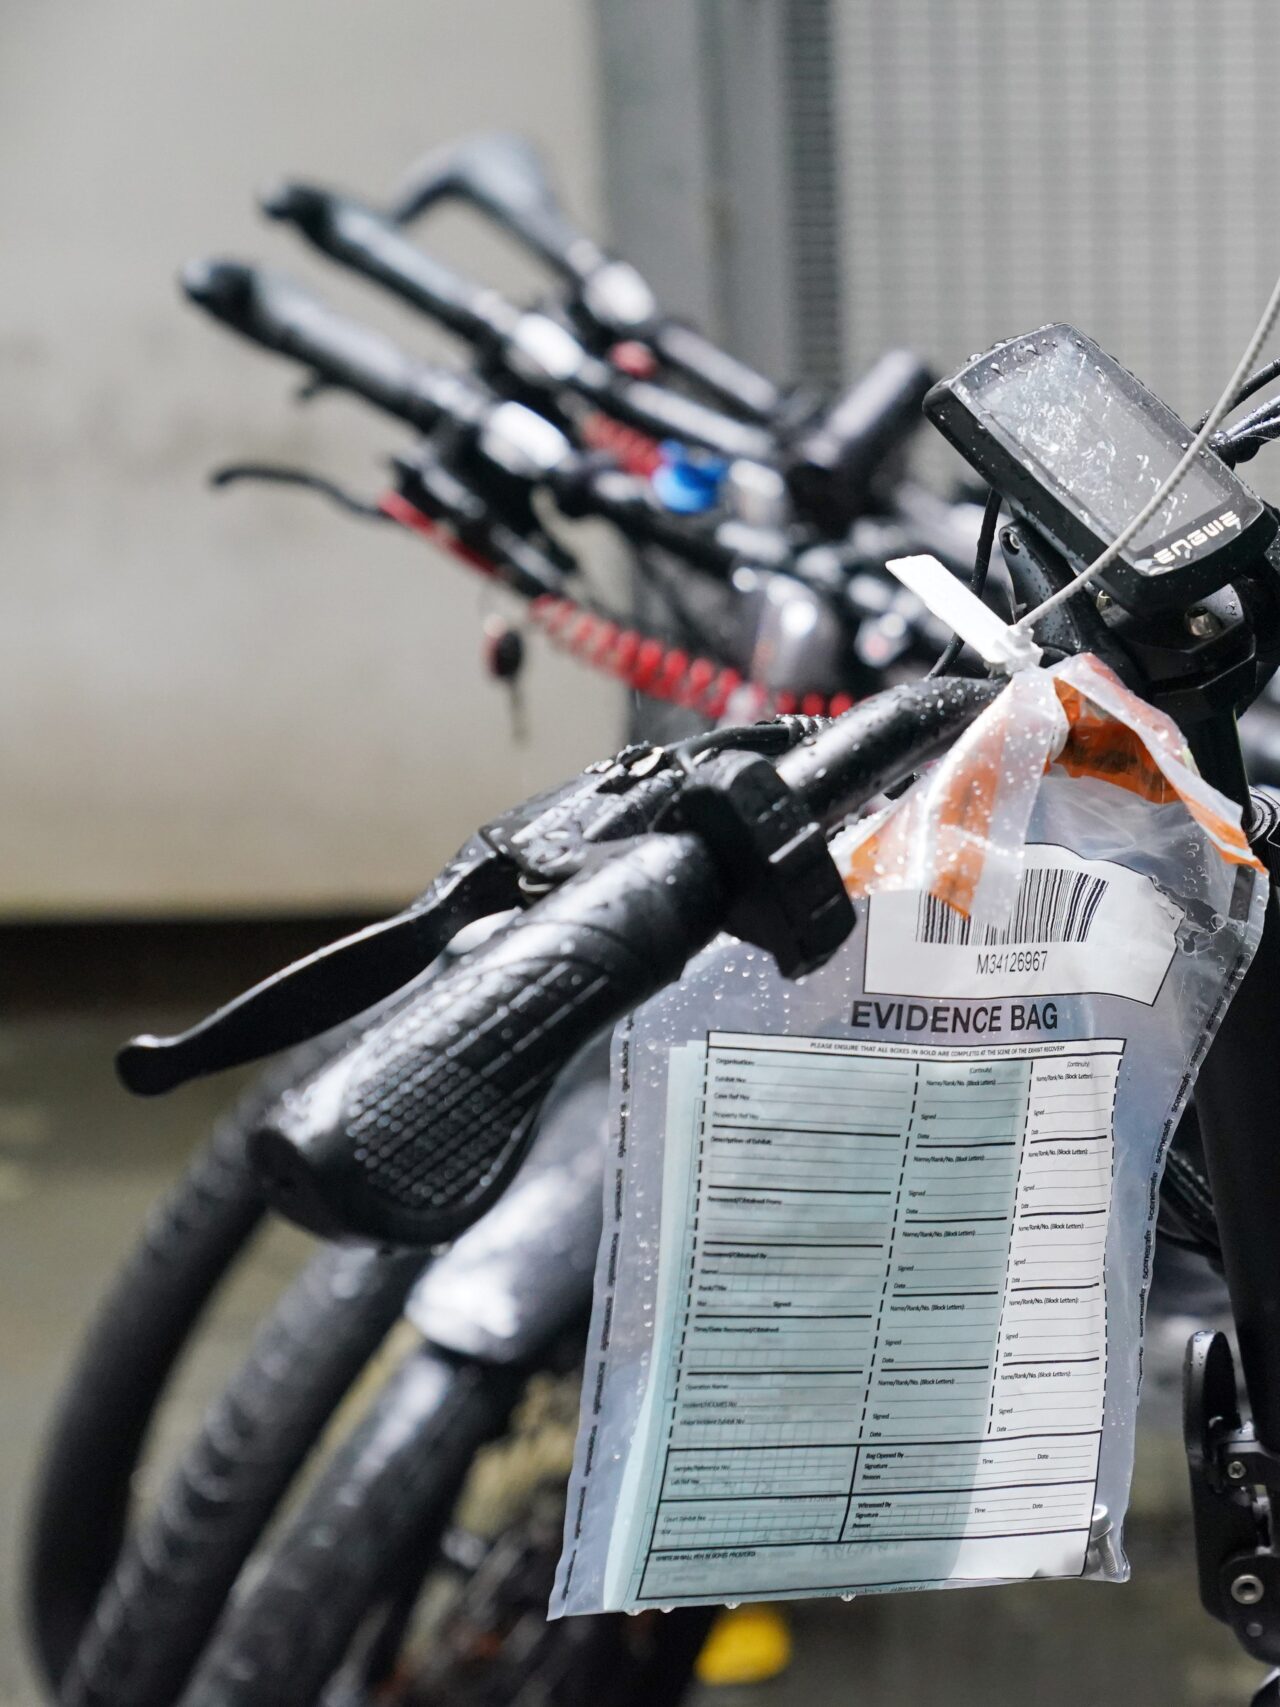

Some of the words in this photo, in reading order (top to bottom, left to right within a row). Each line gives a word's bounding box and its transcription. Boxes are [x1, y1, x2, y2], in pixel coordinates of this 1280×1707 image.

[1154, 511, 1240, 564] ENGWE
[976, 951, 1048, 975] M34126967
[851, 1001, 1002, 1033] EVIDENCE
[1010, 1003, 1058, 1031] BAG
[1171, 1072, 1191, 1112] scenesafe
[1147, 1171, 1158, 1221] scenesafe
[1143, 1229, 1151, 1279] scenesafe
